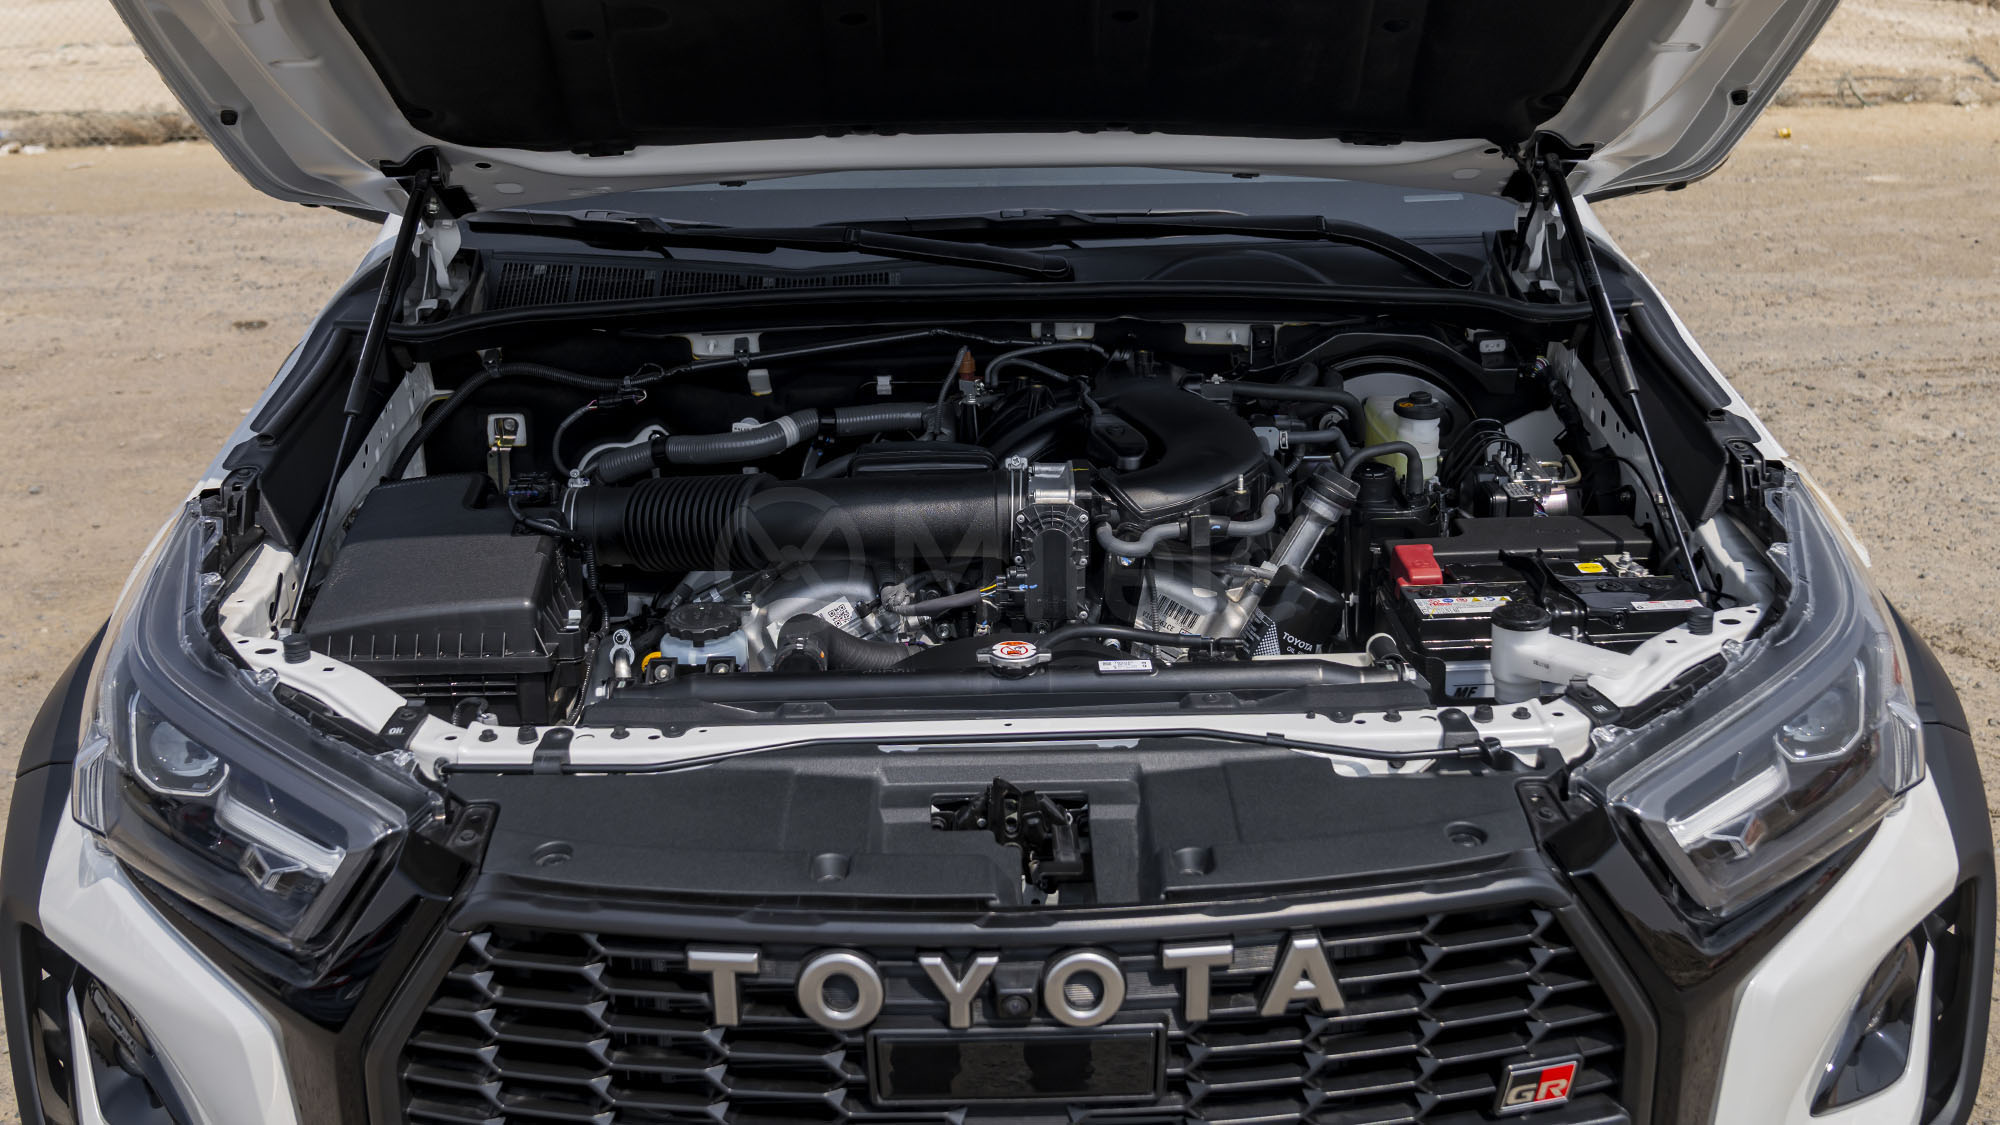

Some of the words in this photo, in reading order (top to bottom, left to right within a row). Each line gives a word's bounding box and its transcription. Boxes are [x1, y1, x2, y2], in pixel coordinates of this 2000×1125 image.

[1282, 631, 1313, 652] TOYOTA
[1454, 686, 1479, 698] MF
[686, 936, 1346, 1030] TOYOTA
[1506, 1079, 1569, 1105] GR
